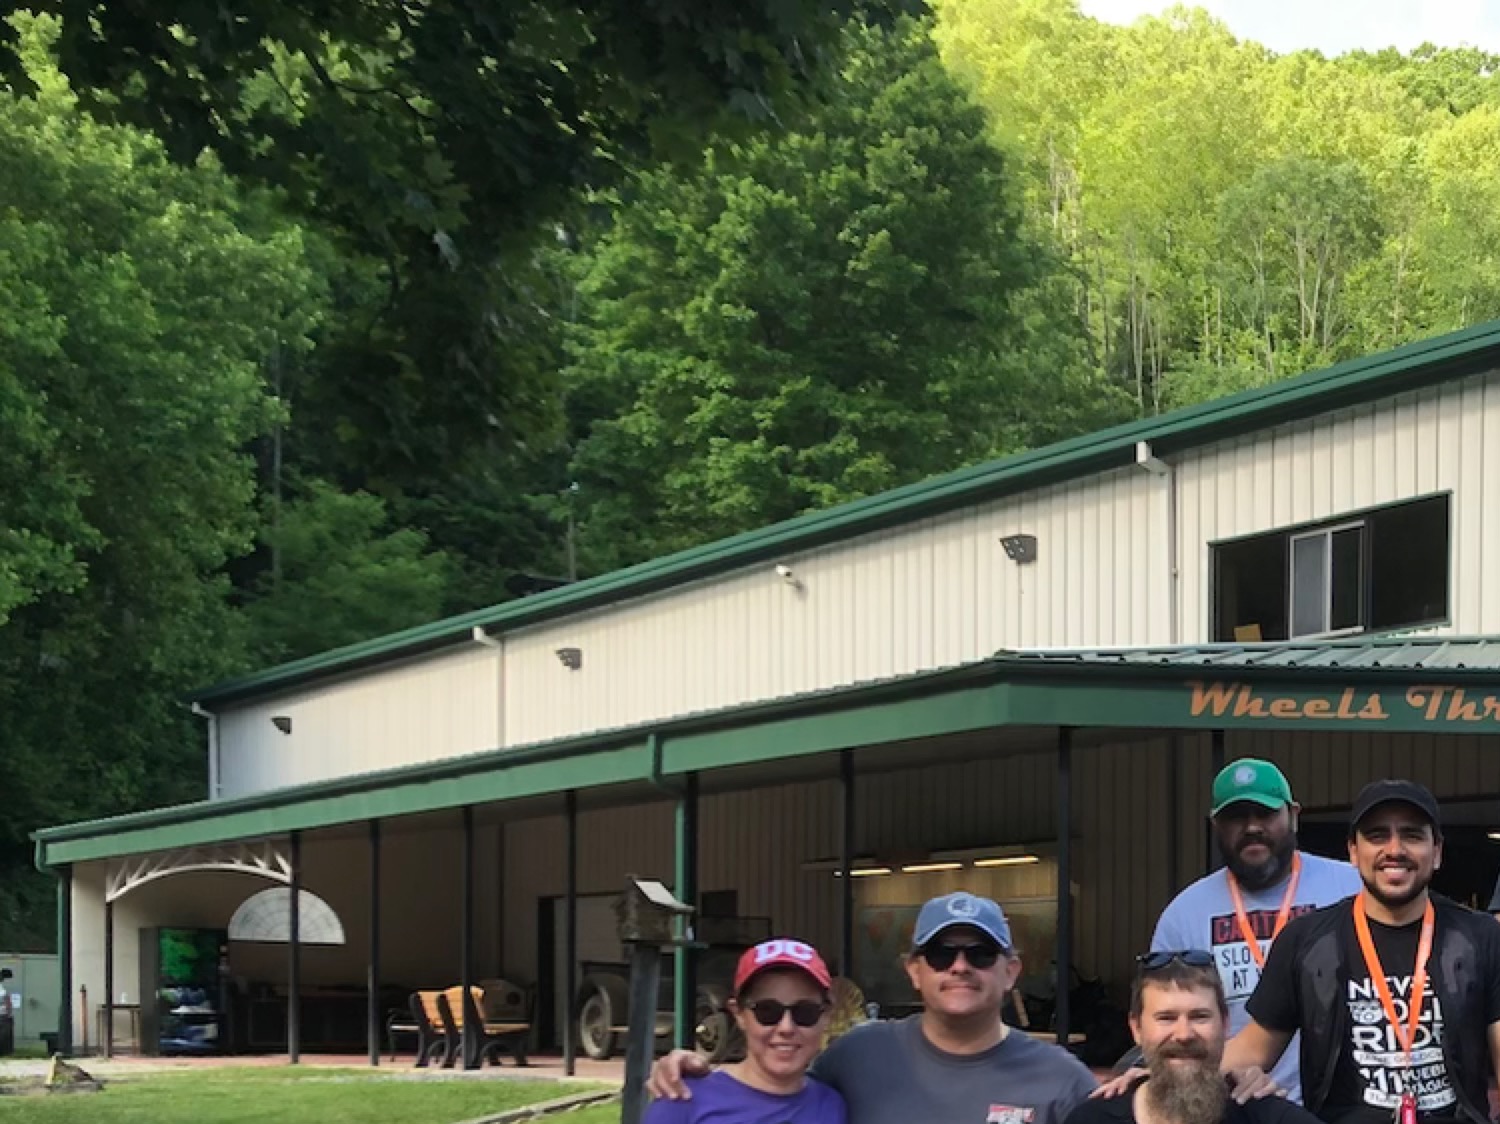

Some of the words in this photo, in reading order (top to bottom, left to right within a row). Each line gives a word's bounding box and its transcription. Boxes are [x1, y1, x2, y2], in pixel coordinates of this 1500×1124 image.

[1185, 680, 1391, 720] Wheels
[753, 939, 814, 965] DC
[1221, 945, 1267, 968] SLO
